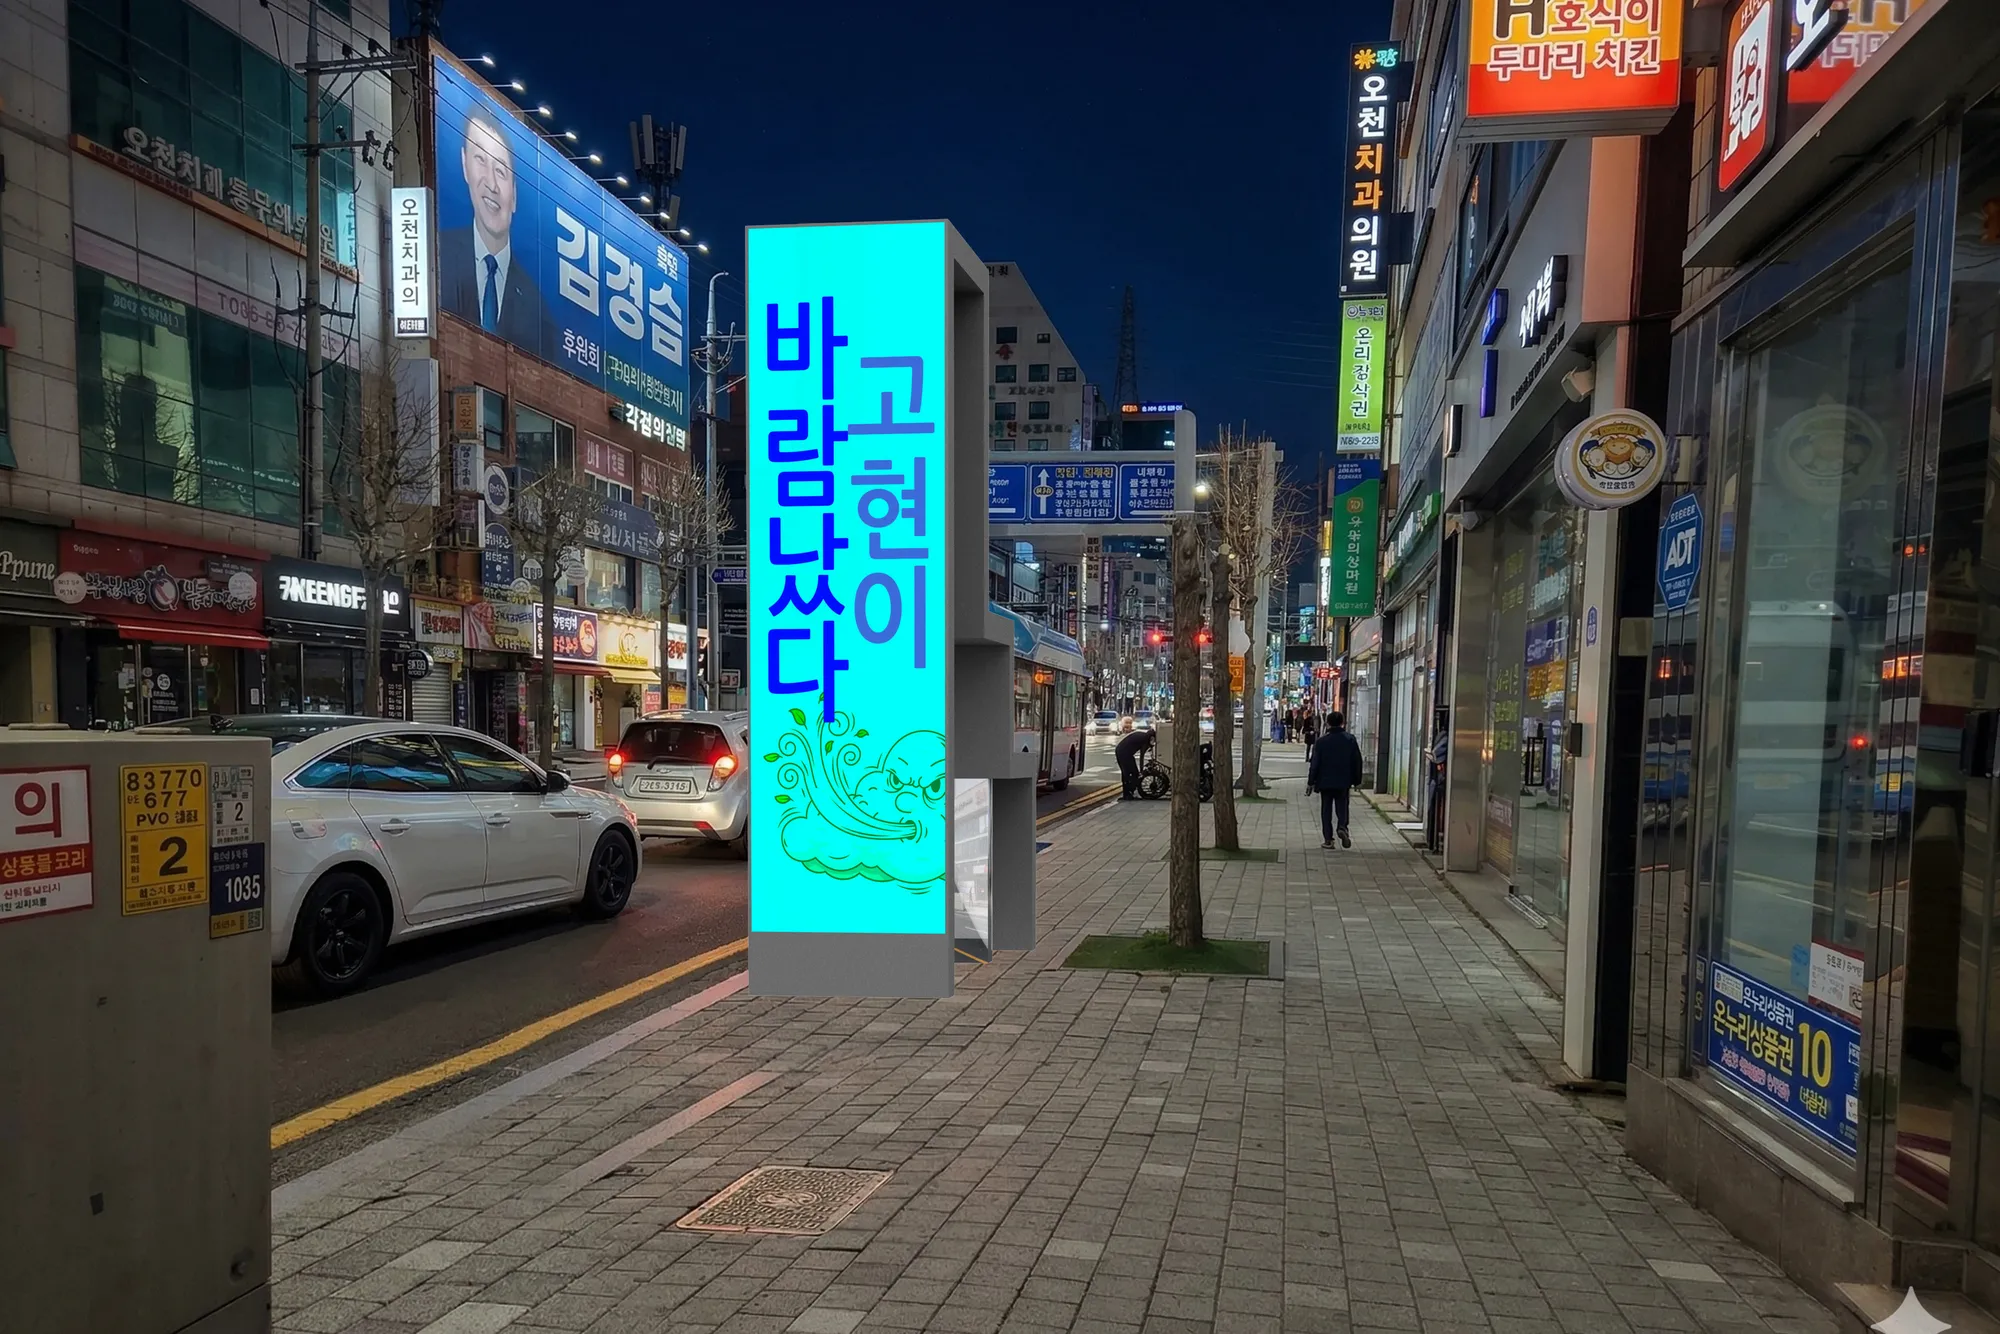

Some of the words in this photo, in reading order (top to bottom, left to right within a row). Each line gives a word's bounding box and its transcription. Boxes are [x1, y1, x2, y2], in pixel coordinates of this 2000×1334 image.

[1551, 0, 1660, 33] 호식이
[1488, 42, 1585, 80] 두마리
[1595, 38, 1660, 75] 치킨
[1350, 75, 1388, 281] 오천치과의원
[400, 198, 420, 306] 오천치과의
[562, 328, 600, 373] 후원회
[767, 296, 849, 723] 바람났다
[848, 355, 935, 669] 고현이
[1664, 527, 1697, 572] ADT
[126, 769, 202, 791] 83770
[144, 790, 188, 809] 677
[14, 782, 62, 838] 의
[136, 812, 170, 826] PVO
[234, 802, 243, 821] 2
[159, 836, 188, 877] 2
[225, 875, 260, 903] 1035
[1743, 986, 1795, 1031] 온누리상품권
[1713, 1000, 1794, 1076] 온누리상품권
[1798, 1022, 1832, 1088] 10
